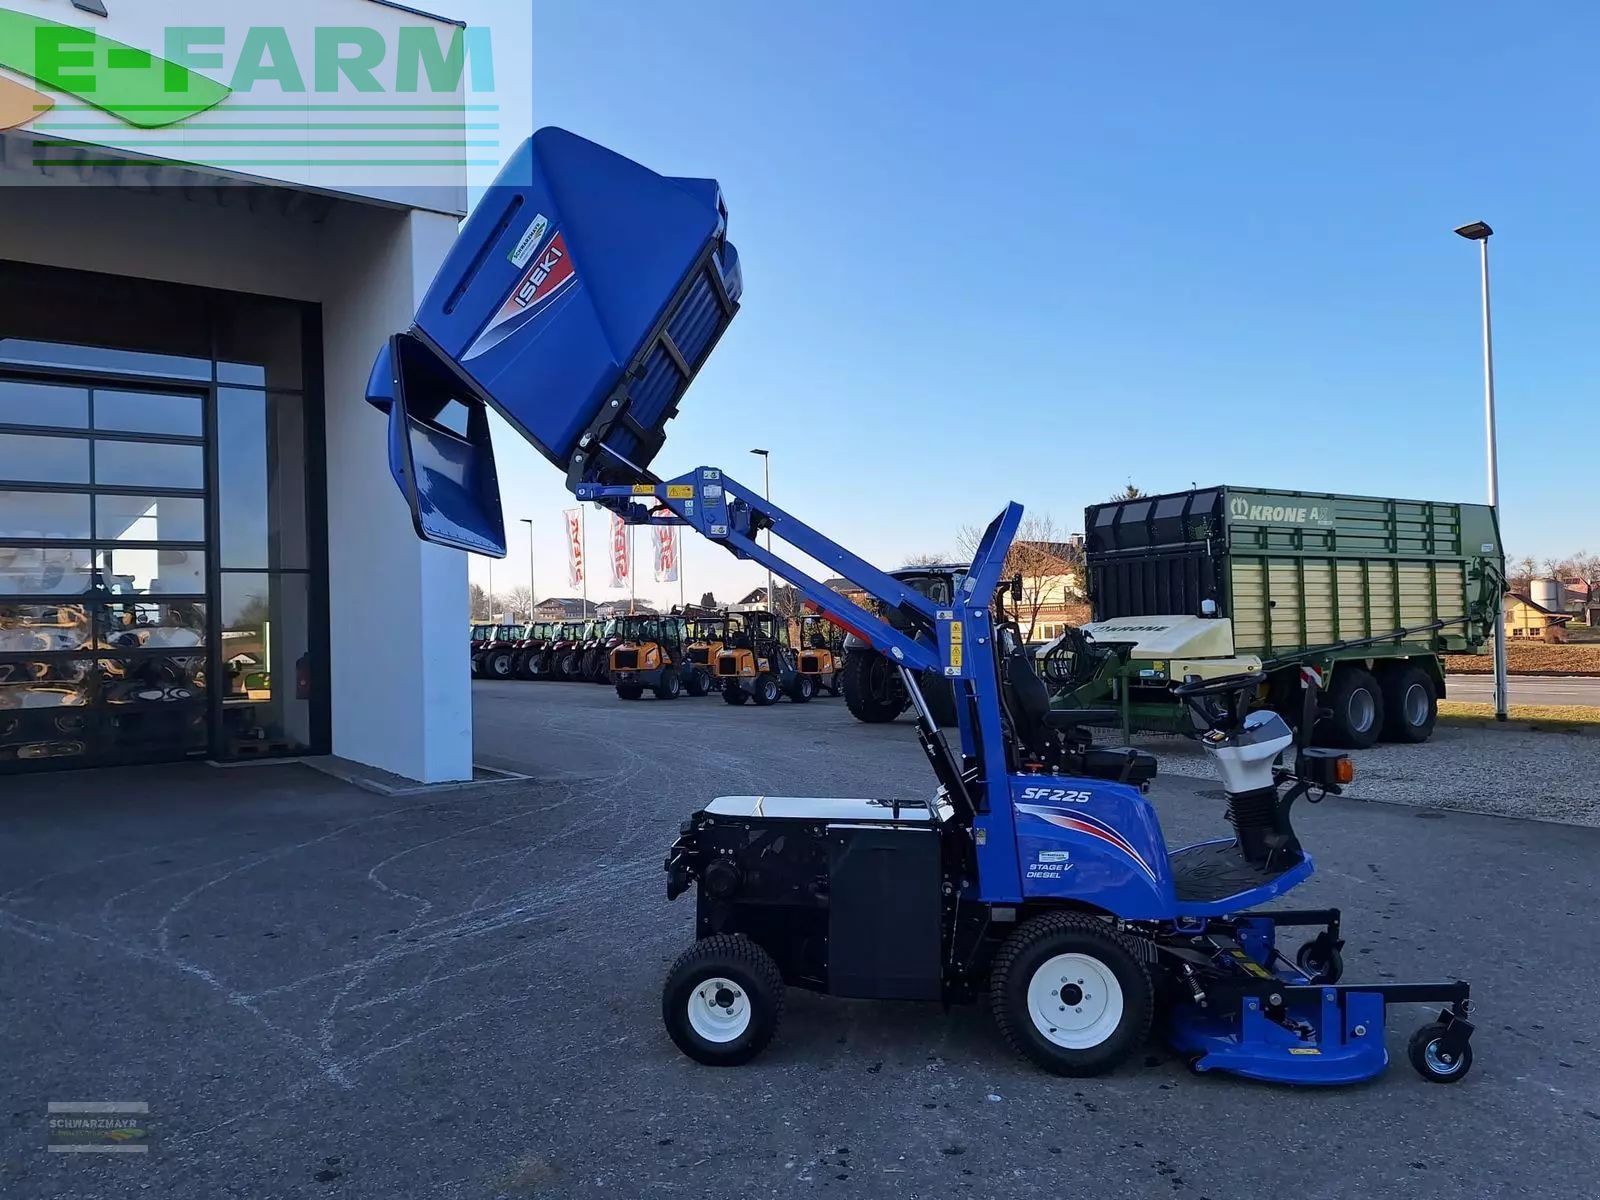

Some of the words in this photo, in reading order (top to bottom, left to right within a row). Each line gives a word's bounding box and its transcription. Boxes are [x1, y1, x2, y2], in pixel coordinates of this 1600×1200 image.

[514, 247, 562, 307] ISEKI
[1249, 505, 1307, 522] KRONE
[1064, 863, 1074, 871] V
